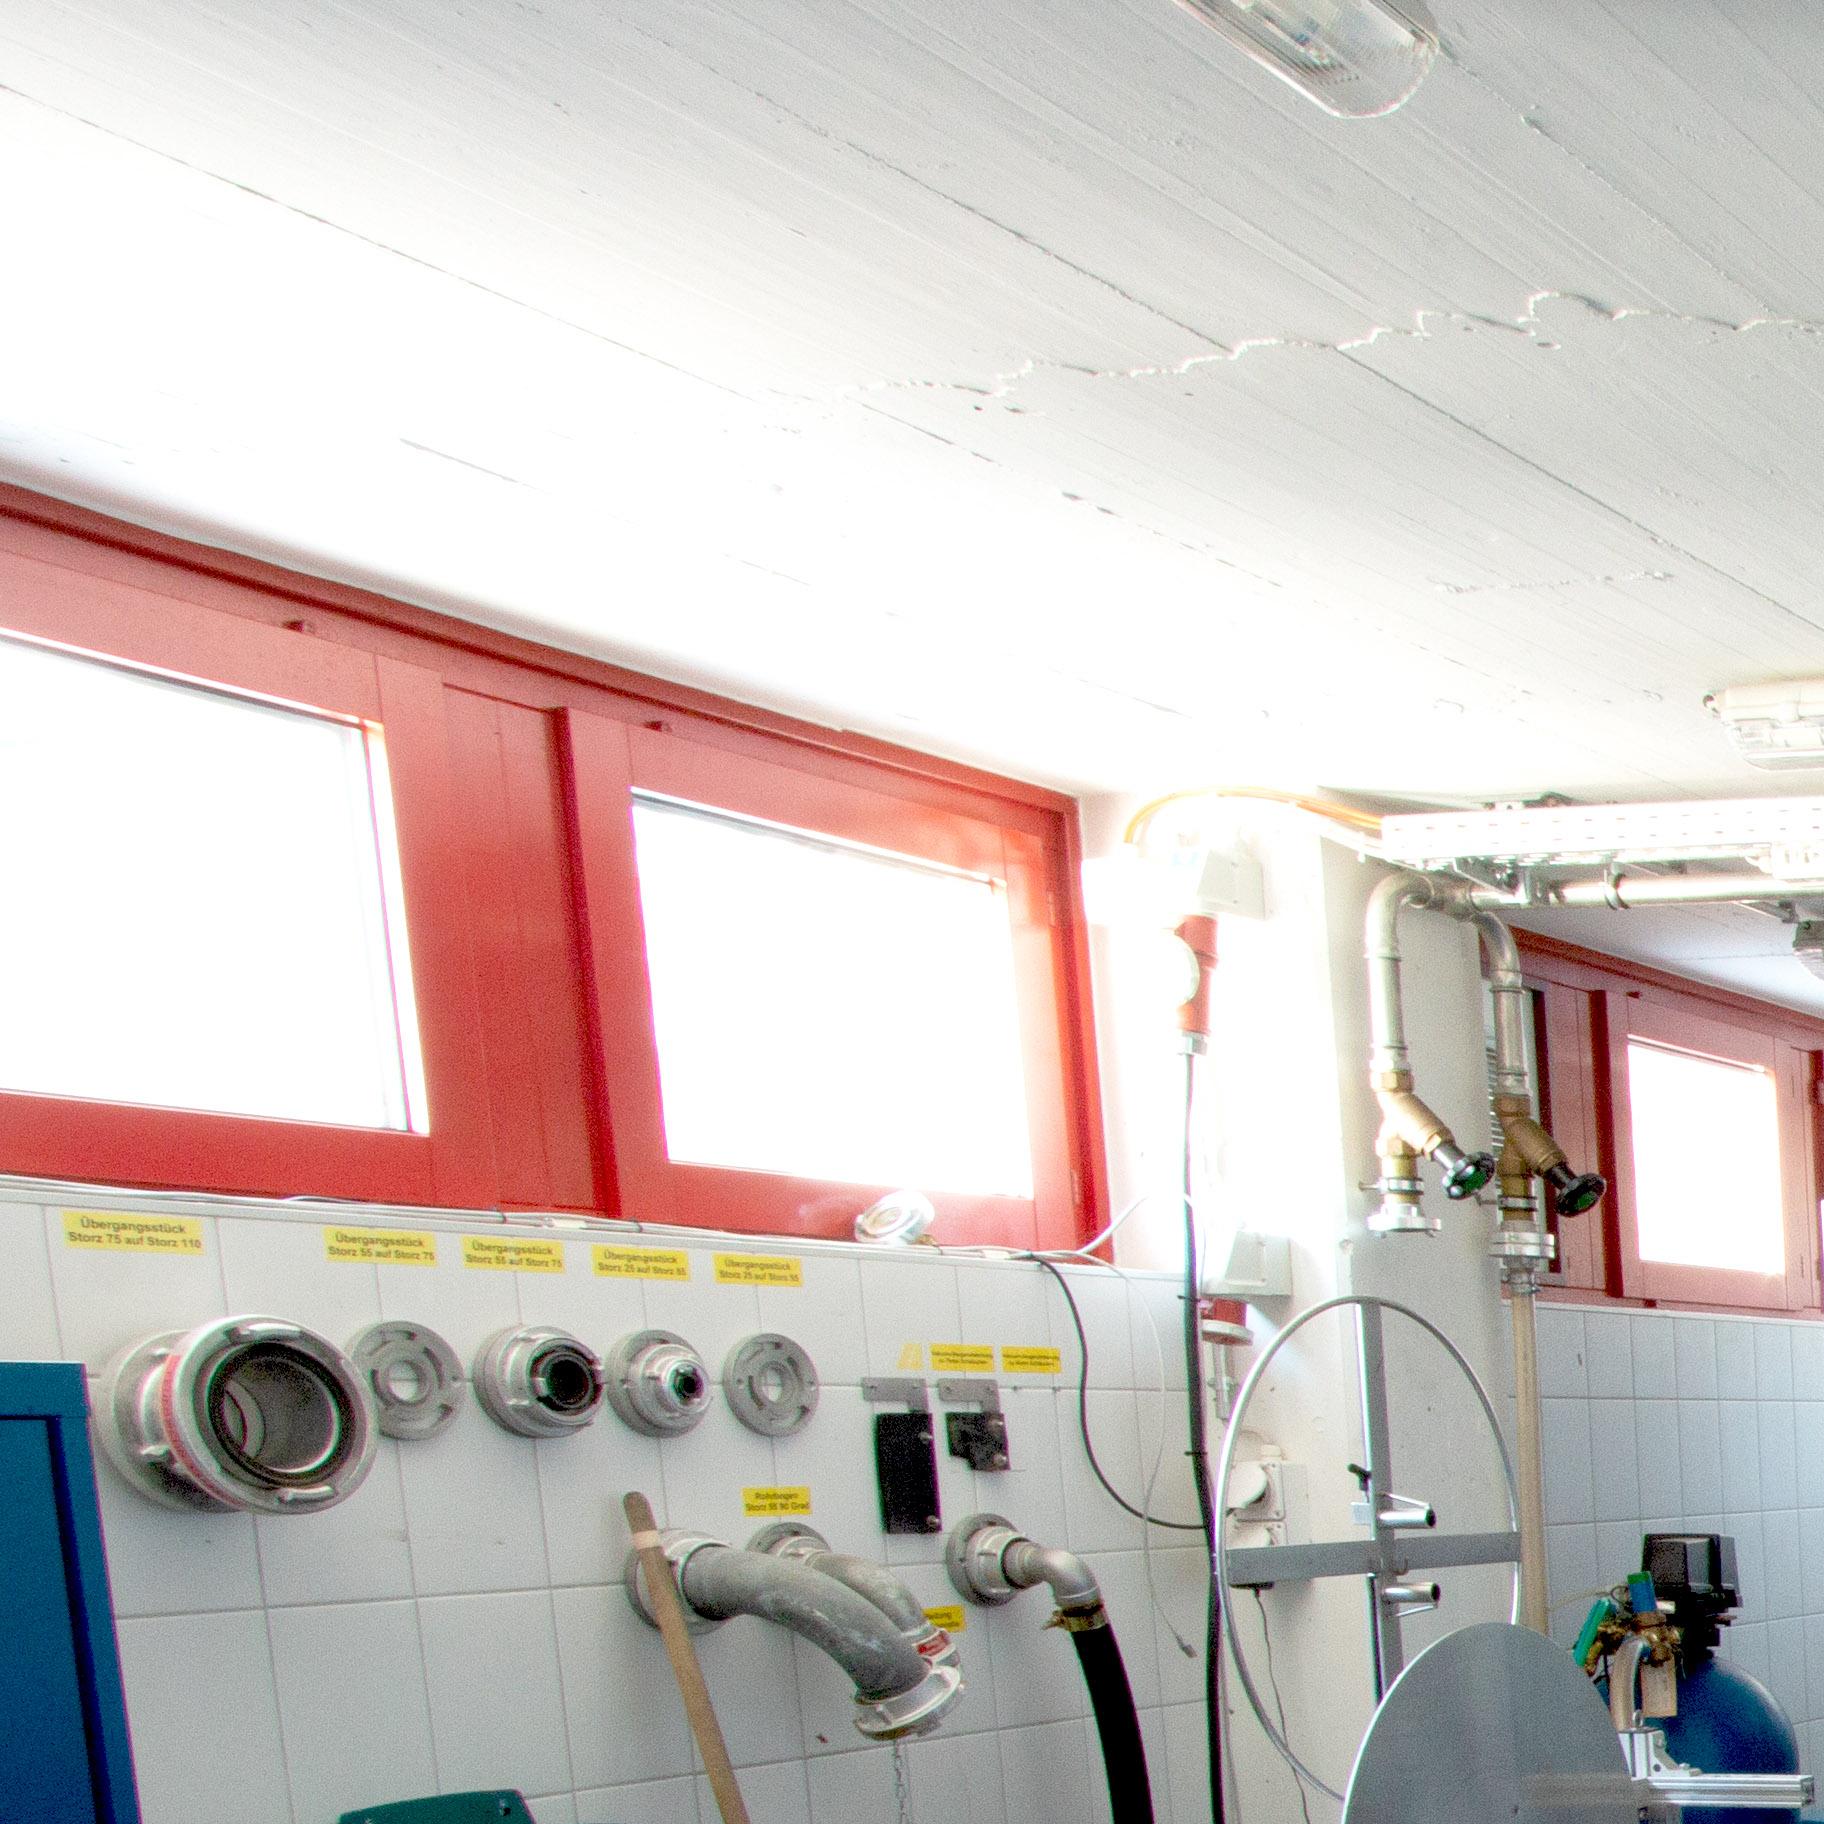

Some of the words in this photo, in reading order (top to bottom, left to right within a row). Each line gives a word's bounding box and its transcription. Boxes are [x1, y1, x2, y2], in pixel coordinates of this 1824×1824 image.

[81, 1215, 185, 1234] Übergangsstück
[68, 1231, 103, 1244] Storz
[106, 1233, 122, 1245] 75
[125, 1235, 144, 1246] auf
[147, 1236, 178, 1248] Storz
[182, 1238, 202, 1249] 110
[335, 1230, 424, 1248] Übergangsstück
[471, 1239, 553, 1255] Übergangsstück
[328, 1245, 357, 1257] Storz
[375, 1248, 392, 1258] auf
[394, 1249, 421, 1260] Storz
[422, 1250, 435, 1261] 75
[465, 1253, 492, 1264] Storz
[508, 1256, 523, 1266] auf
[525, 1257, 549, 1267] Storz
[603, 1248, 677, 1264] Übergangsstück
